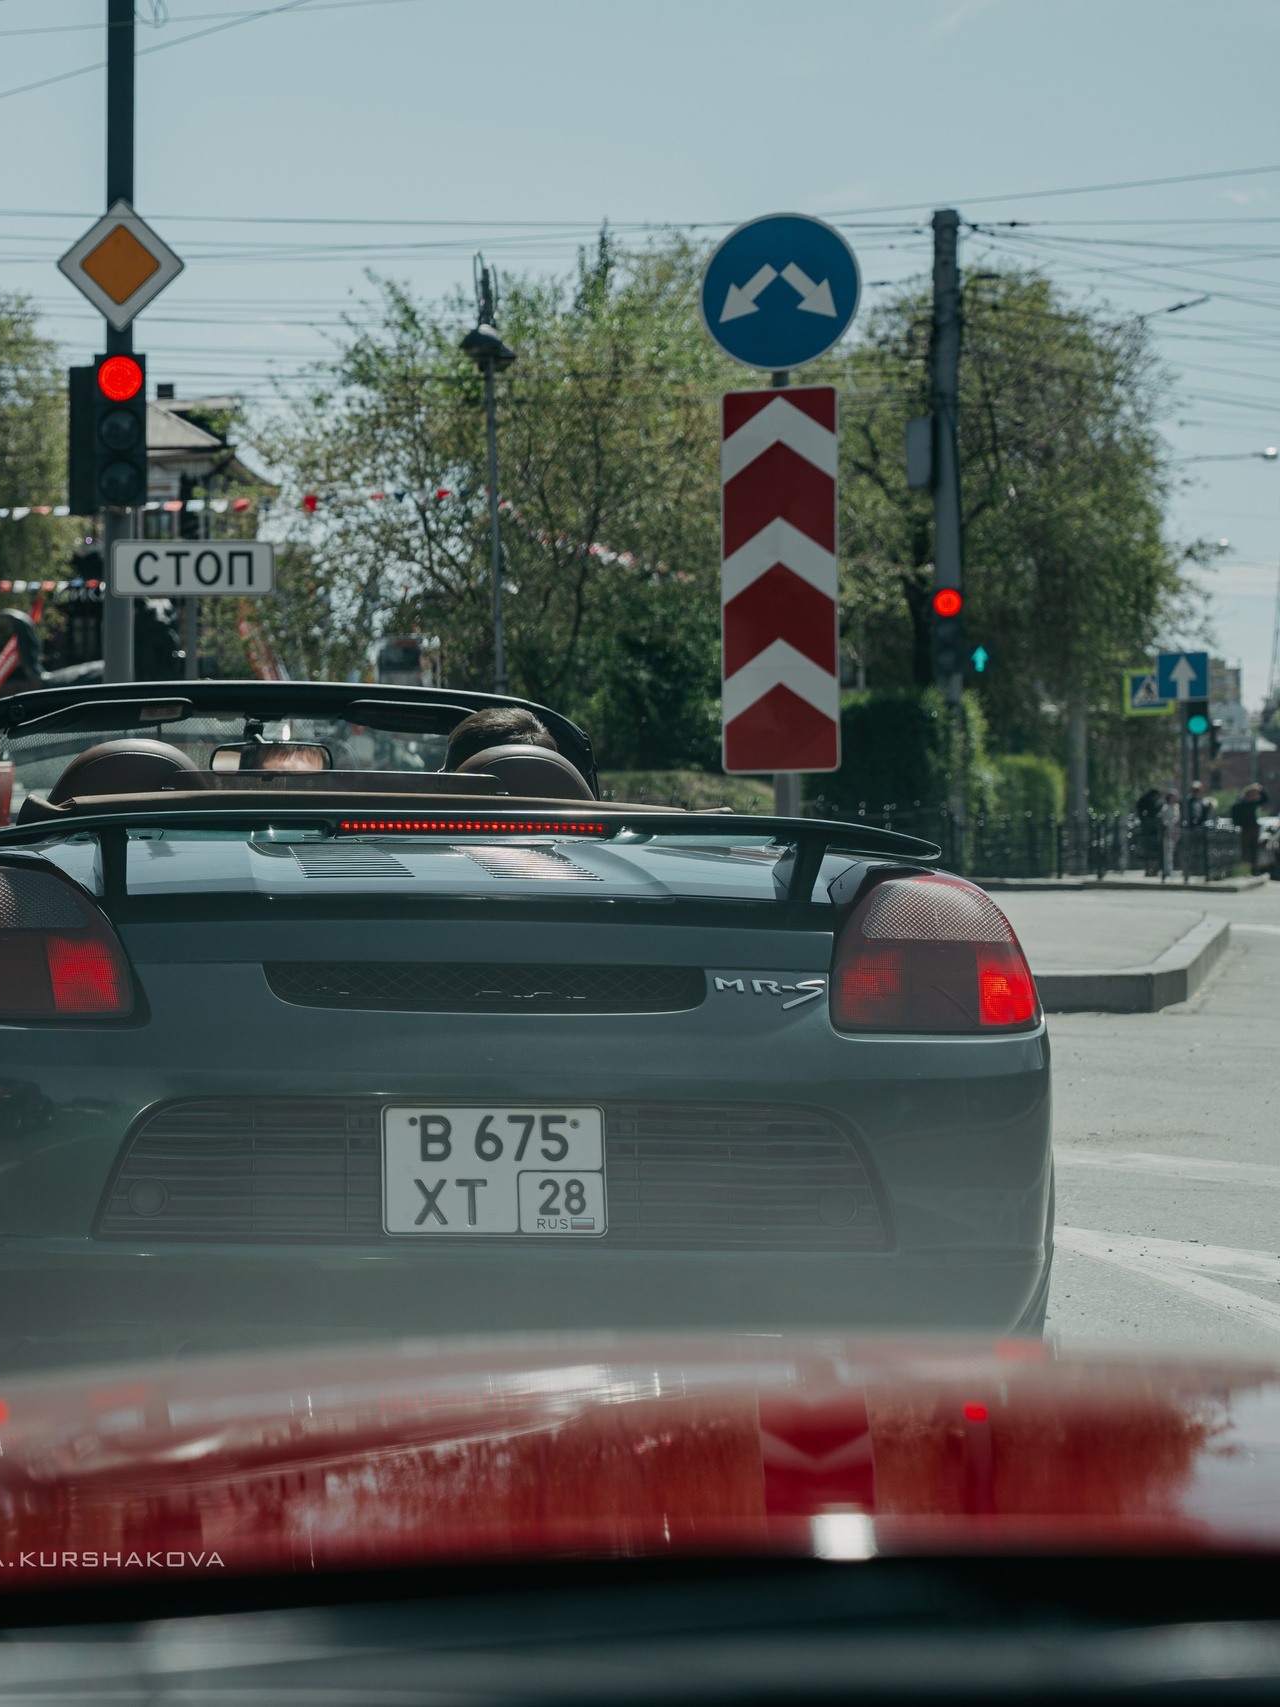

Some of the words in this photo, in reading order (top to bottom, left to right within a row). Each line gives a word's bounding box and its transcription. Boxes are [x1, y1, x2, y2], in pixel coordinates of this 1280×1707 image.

[134, 551, 253, 586] СТОП
[714, 976, 826, 1009] MR-S
[413, 1178, 488, 1225] ХТ
[538, 1178, 586, 1216] 28
[536, 1218, 569, 1230] RUS
